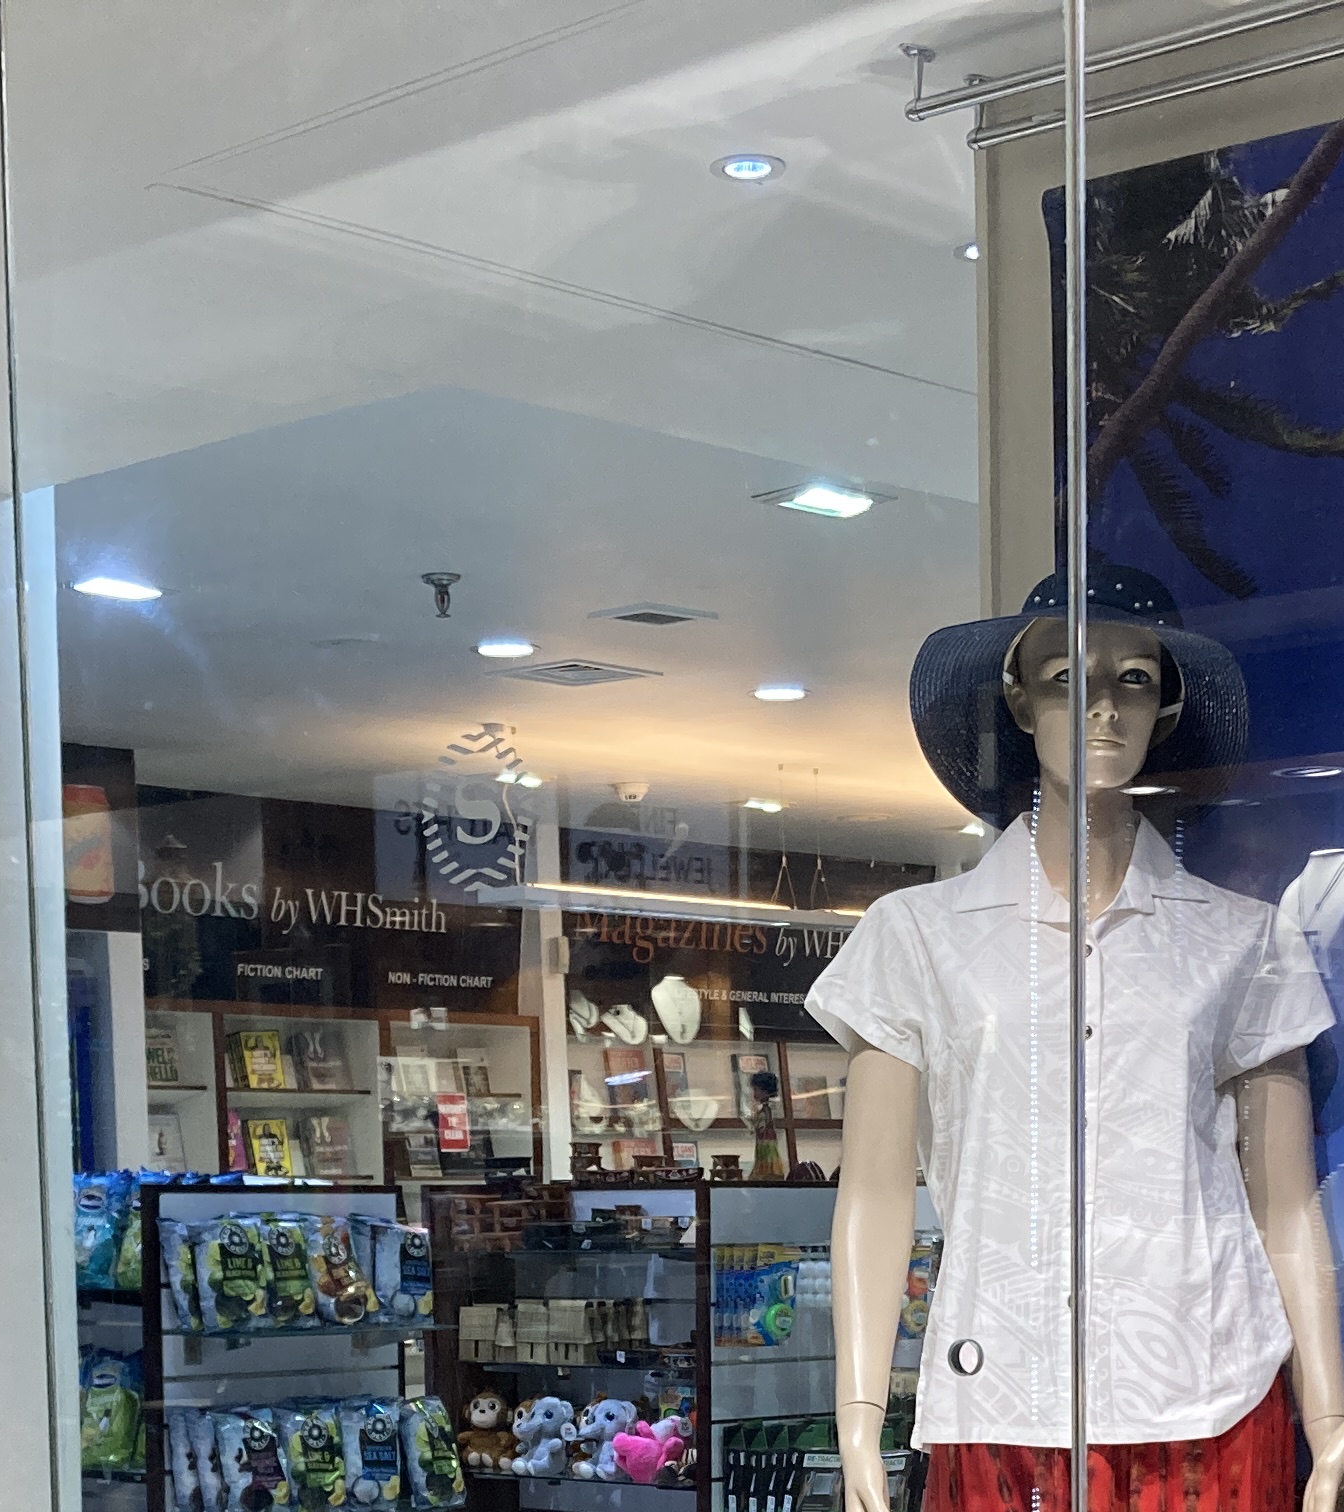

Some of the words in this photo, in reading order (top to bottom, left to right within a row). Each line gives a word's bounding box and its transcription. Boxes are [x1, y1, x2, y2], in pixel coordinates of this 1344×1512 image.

[138, 860, 259, 921] ooks
[270, 887, 300, 934] by
[304, 887, 448, 934] WHSmith
[774, 928, 798, 967] by
[237, 964, 282, 979] FICTION
[284, 966, 324, 981] CHART
[388, 971, 411, 985] NON
[418, 972, 458, 987] FICTION
[459, 974, 494, 988] CHART
[728, 990, 770, 1003] GENERAL
[770, 991, 806, 1005] INTERES
